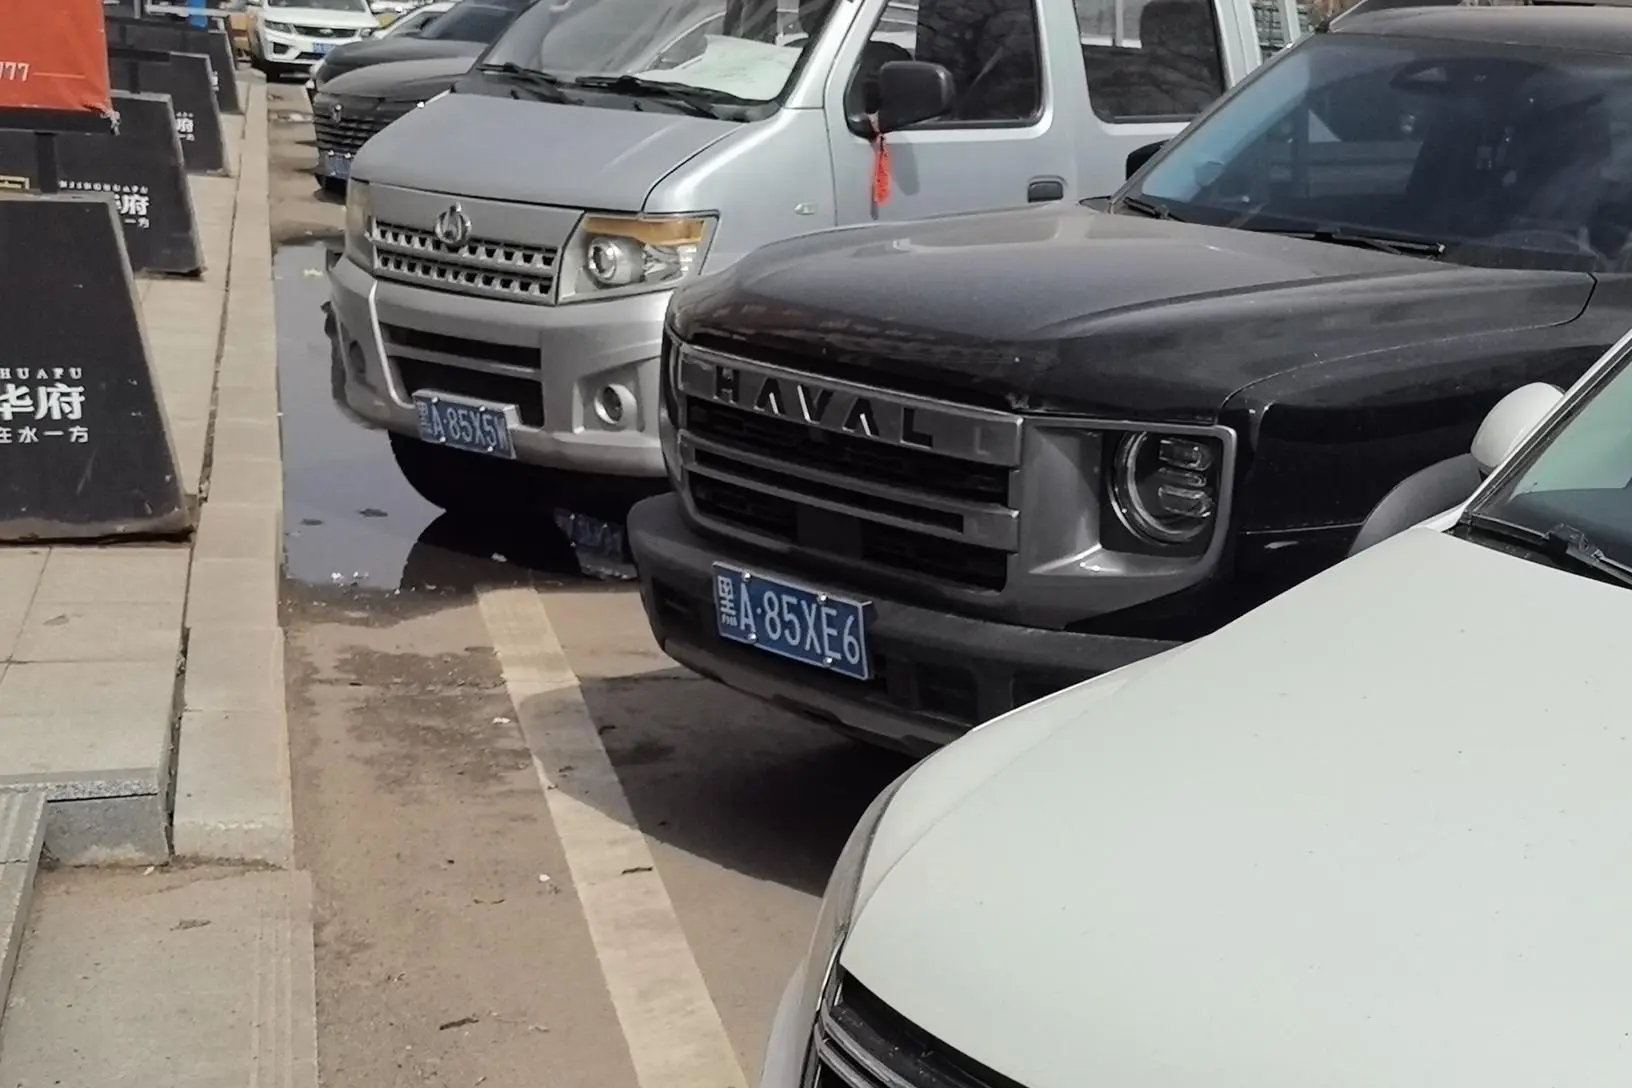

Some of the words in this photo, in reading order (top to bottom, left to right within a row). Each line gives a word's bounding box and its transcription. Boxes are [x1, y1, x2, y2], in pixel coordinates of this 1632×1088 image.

[0, 367, 83, 380] HUAFU
[0, 382, 86, 421] 华府
[715, 366, 933, 449] HAVAL
